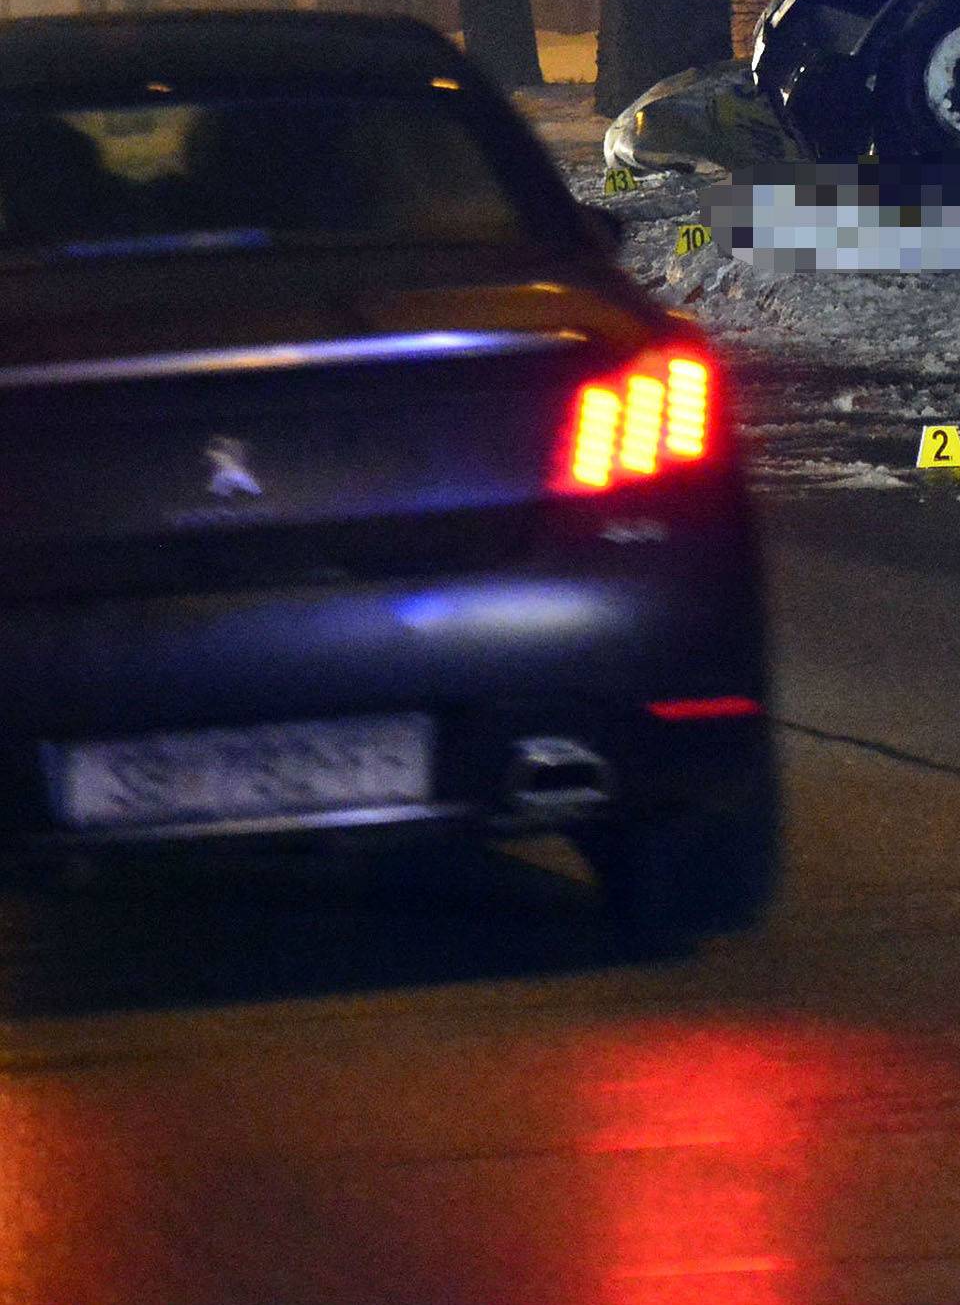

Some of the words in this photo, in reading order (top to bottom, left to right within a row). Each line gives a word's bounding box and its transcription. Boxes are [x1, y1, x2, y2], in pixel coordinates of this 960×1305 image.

[608, 170, 629, 192] 13
[681, 227, 706, 254] 10
[932, 429, 951, 462] 2
